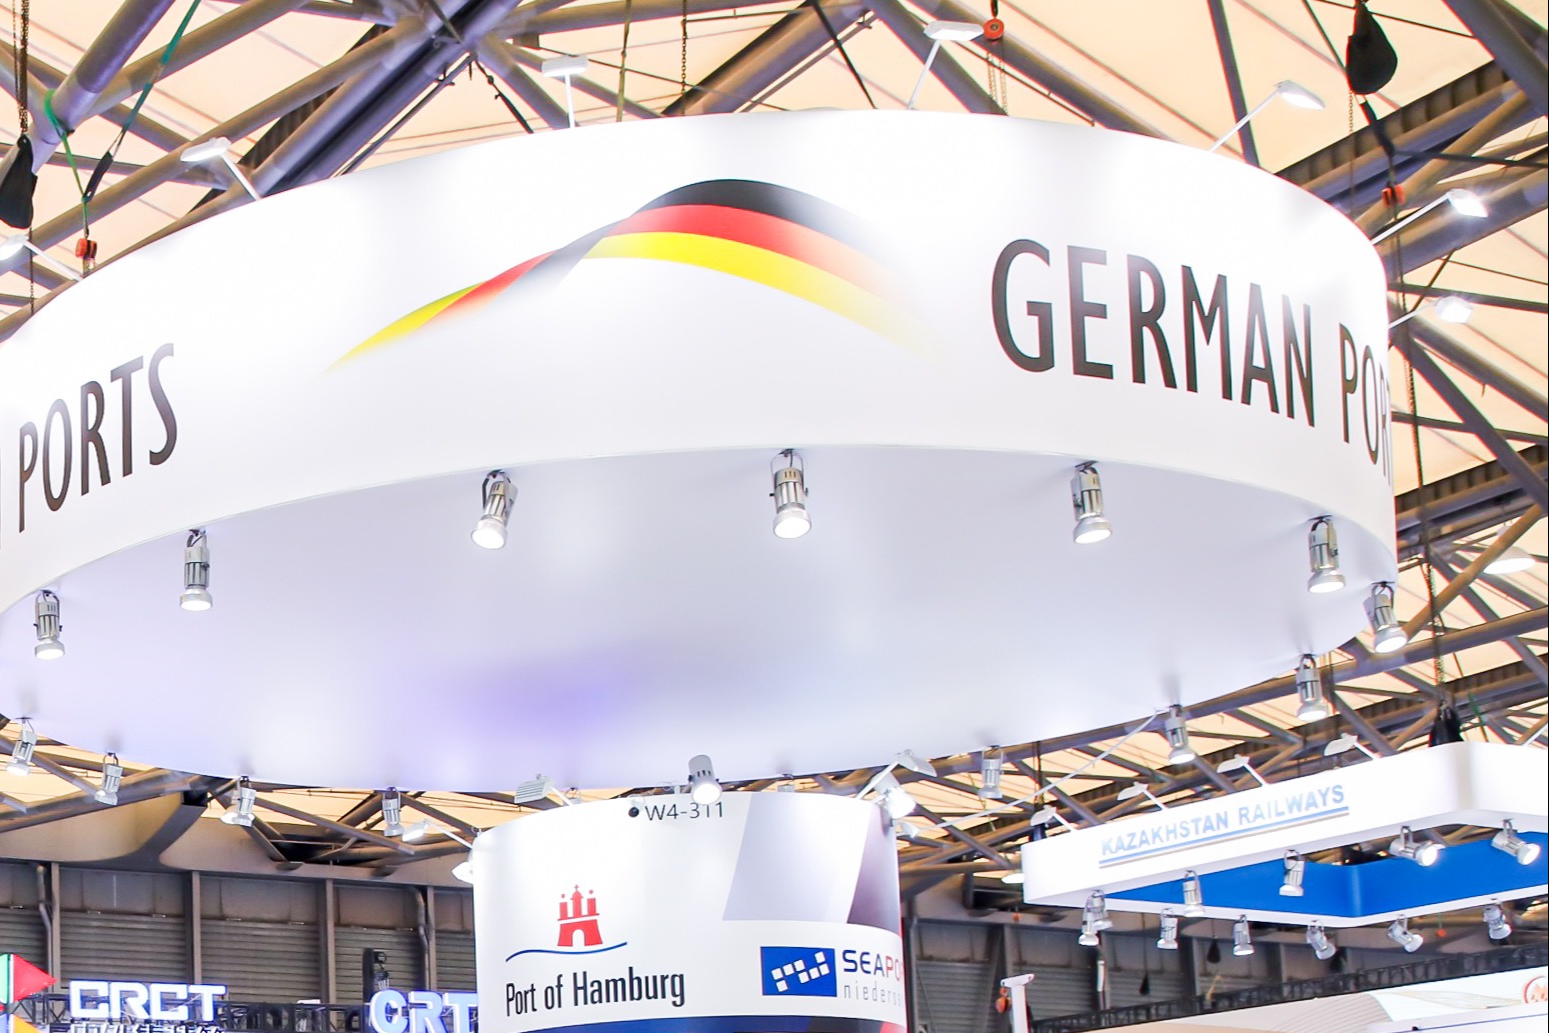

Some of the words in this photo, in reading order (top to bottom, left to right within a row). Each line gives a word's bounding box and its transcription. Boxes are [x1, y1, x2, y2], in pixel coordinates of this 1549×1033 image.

[991, 238, 1315, 428] GERMAN
[19, 342, 178, 534] PORTS
[644, 801, 723, 821] W4-311
[1100, 811, 1229, 856] KAZAKHSTAN
[1238, 784, 1346, 823] RAILWAYS
[68, 979, 227, 1022] CRCT
[506, 982, 537, 1017] Port
[544, 974, 563, 1010] of
[573, 966, 686, 1008] Hamburg
